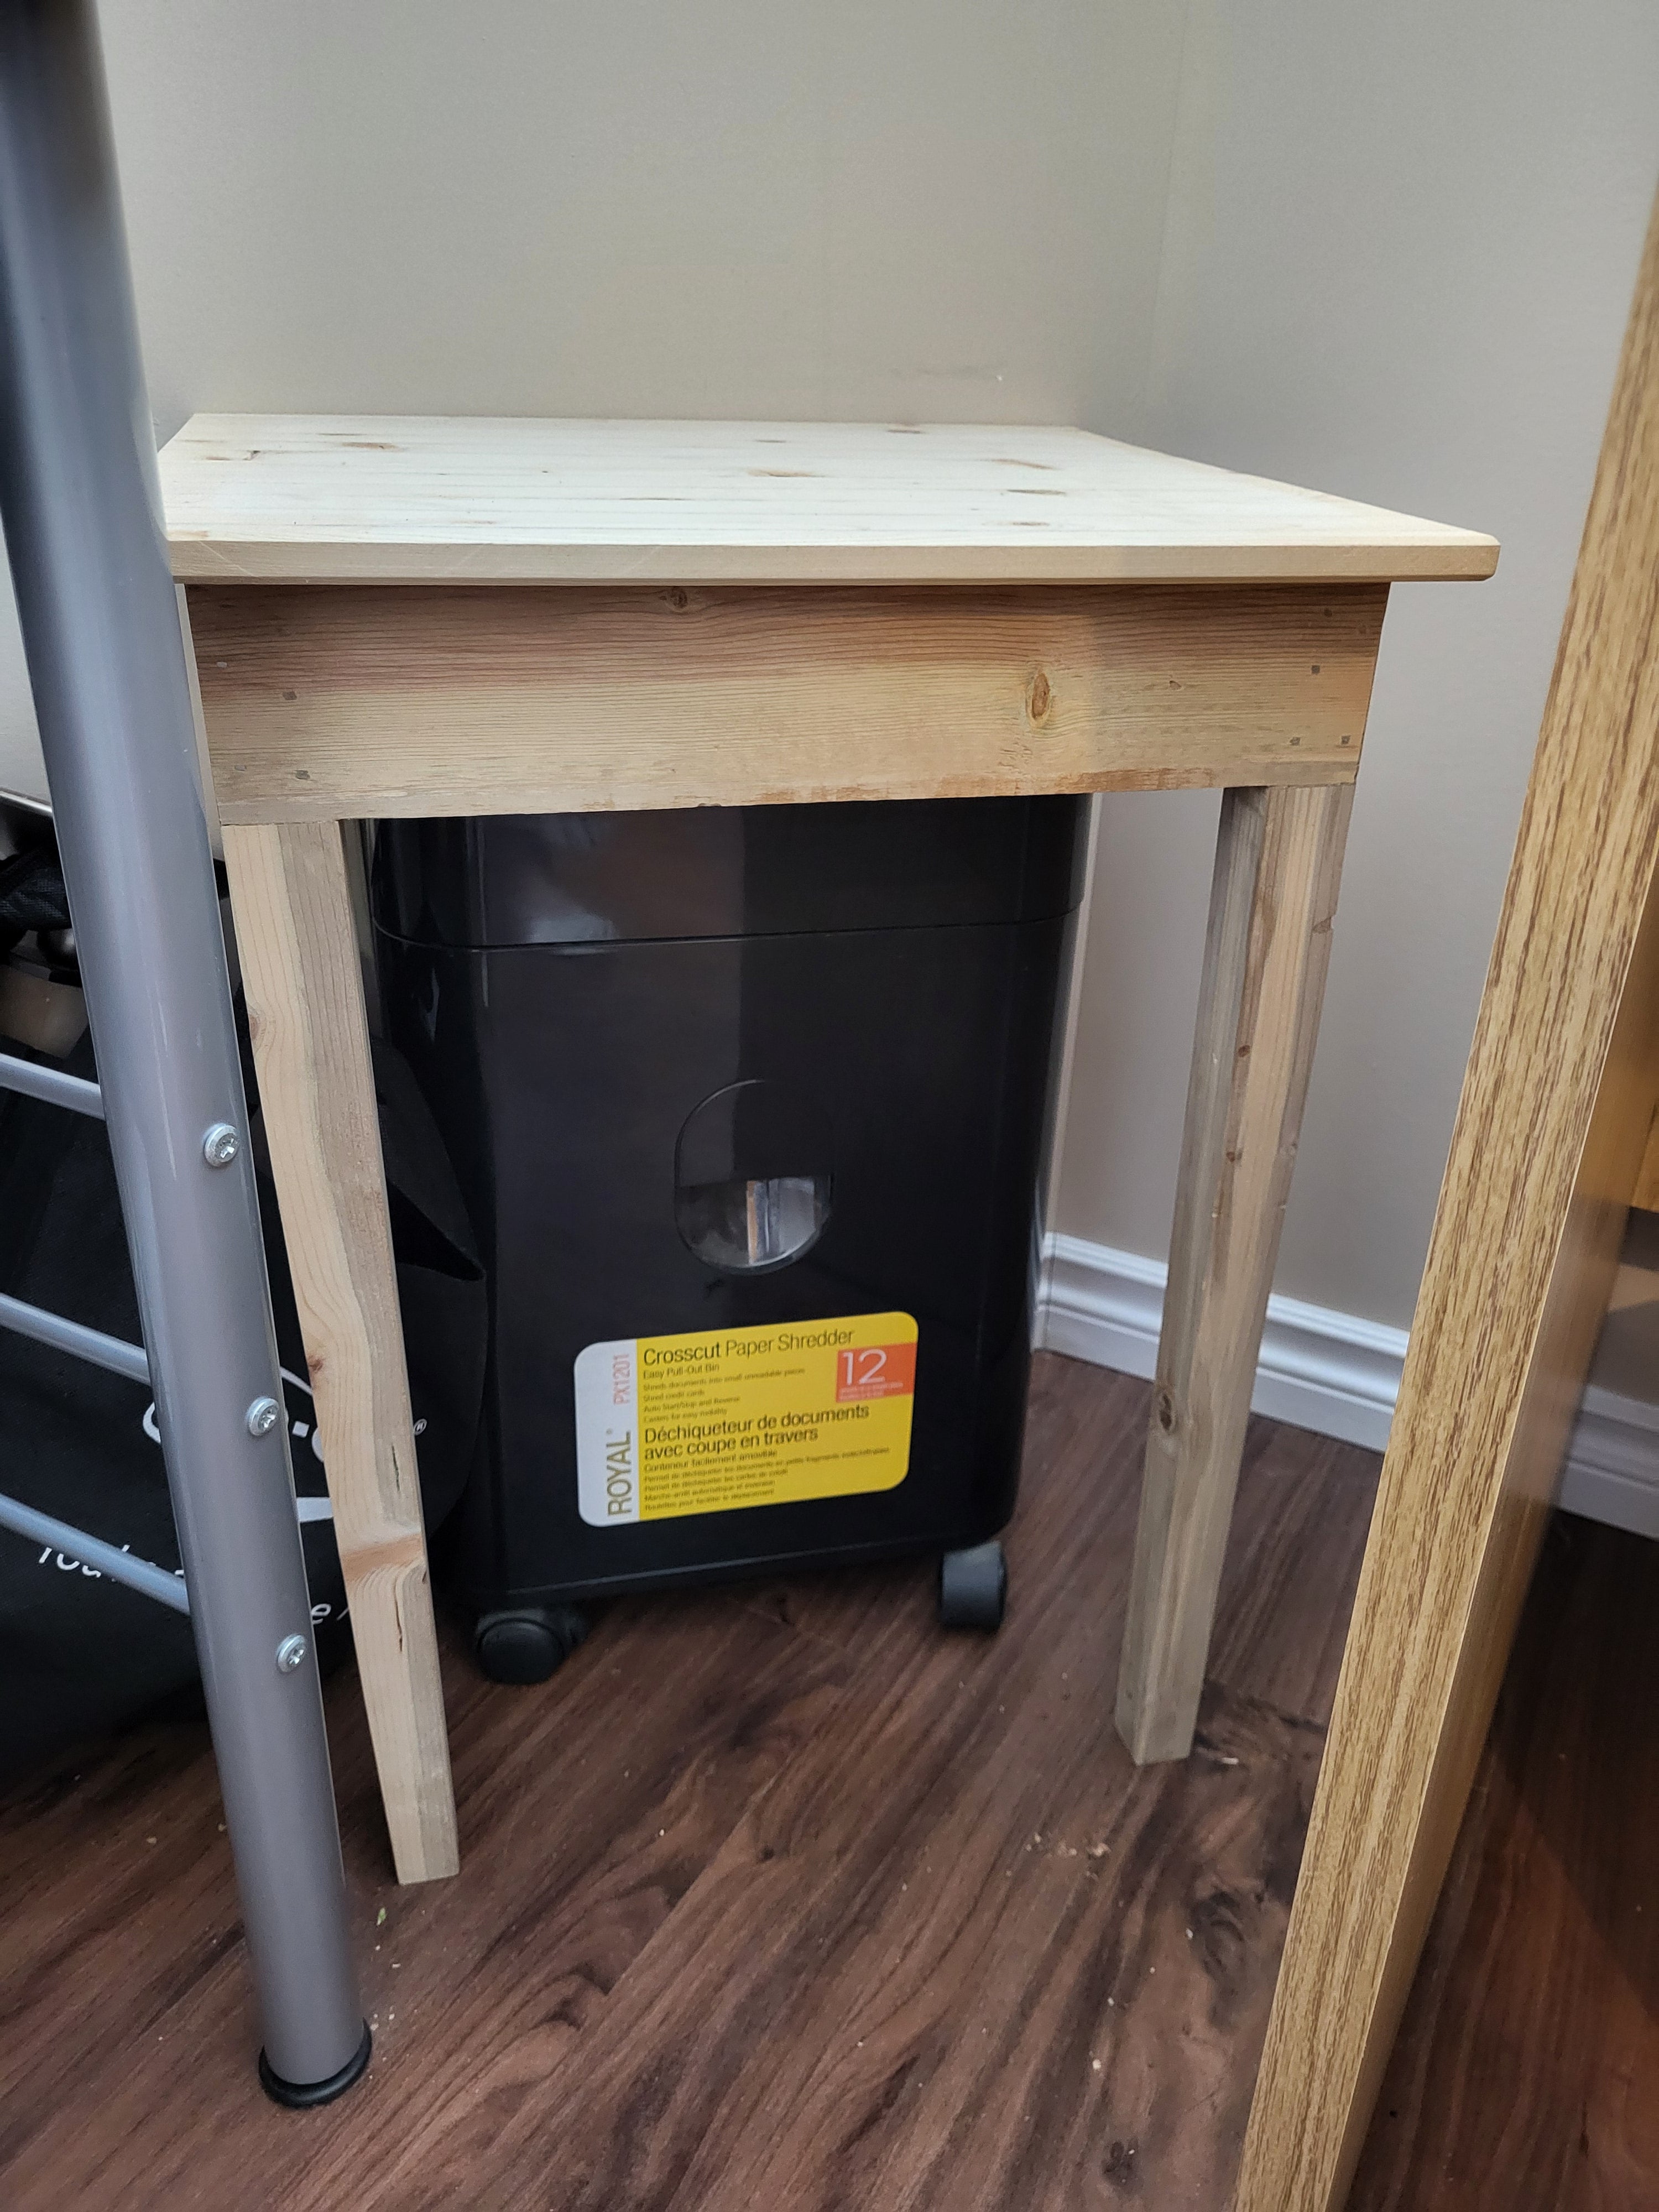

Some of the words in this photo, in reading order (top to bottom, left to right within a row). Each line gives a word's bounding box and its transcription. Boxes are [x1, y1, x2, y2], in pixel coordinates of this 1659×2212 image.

[644, 1342, 721, 1366] Crosscut
[727, 1338, 774, 1359] Paper
[778, 1328, 855, 1351] Shredder
[643, 1369, 664, 1380] Easy
[706, 1363, 721, 1374] Bin
[842, 1348, 888, 1386] 12
[644, 1420, 754, 1444] Déchiqueteur
[757, 1414, 778, 1431] de
[781, 1404, 870, 1427] documents
[644, 1443, 684, 1460] avec
[687, 1437, 737, 1454] coupe
[740, 1433, 760, 1448] en
[764, 1427, 819, 1446] travers
